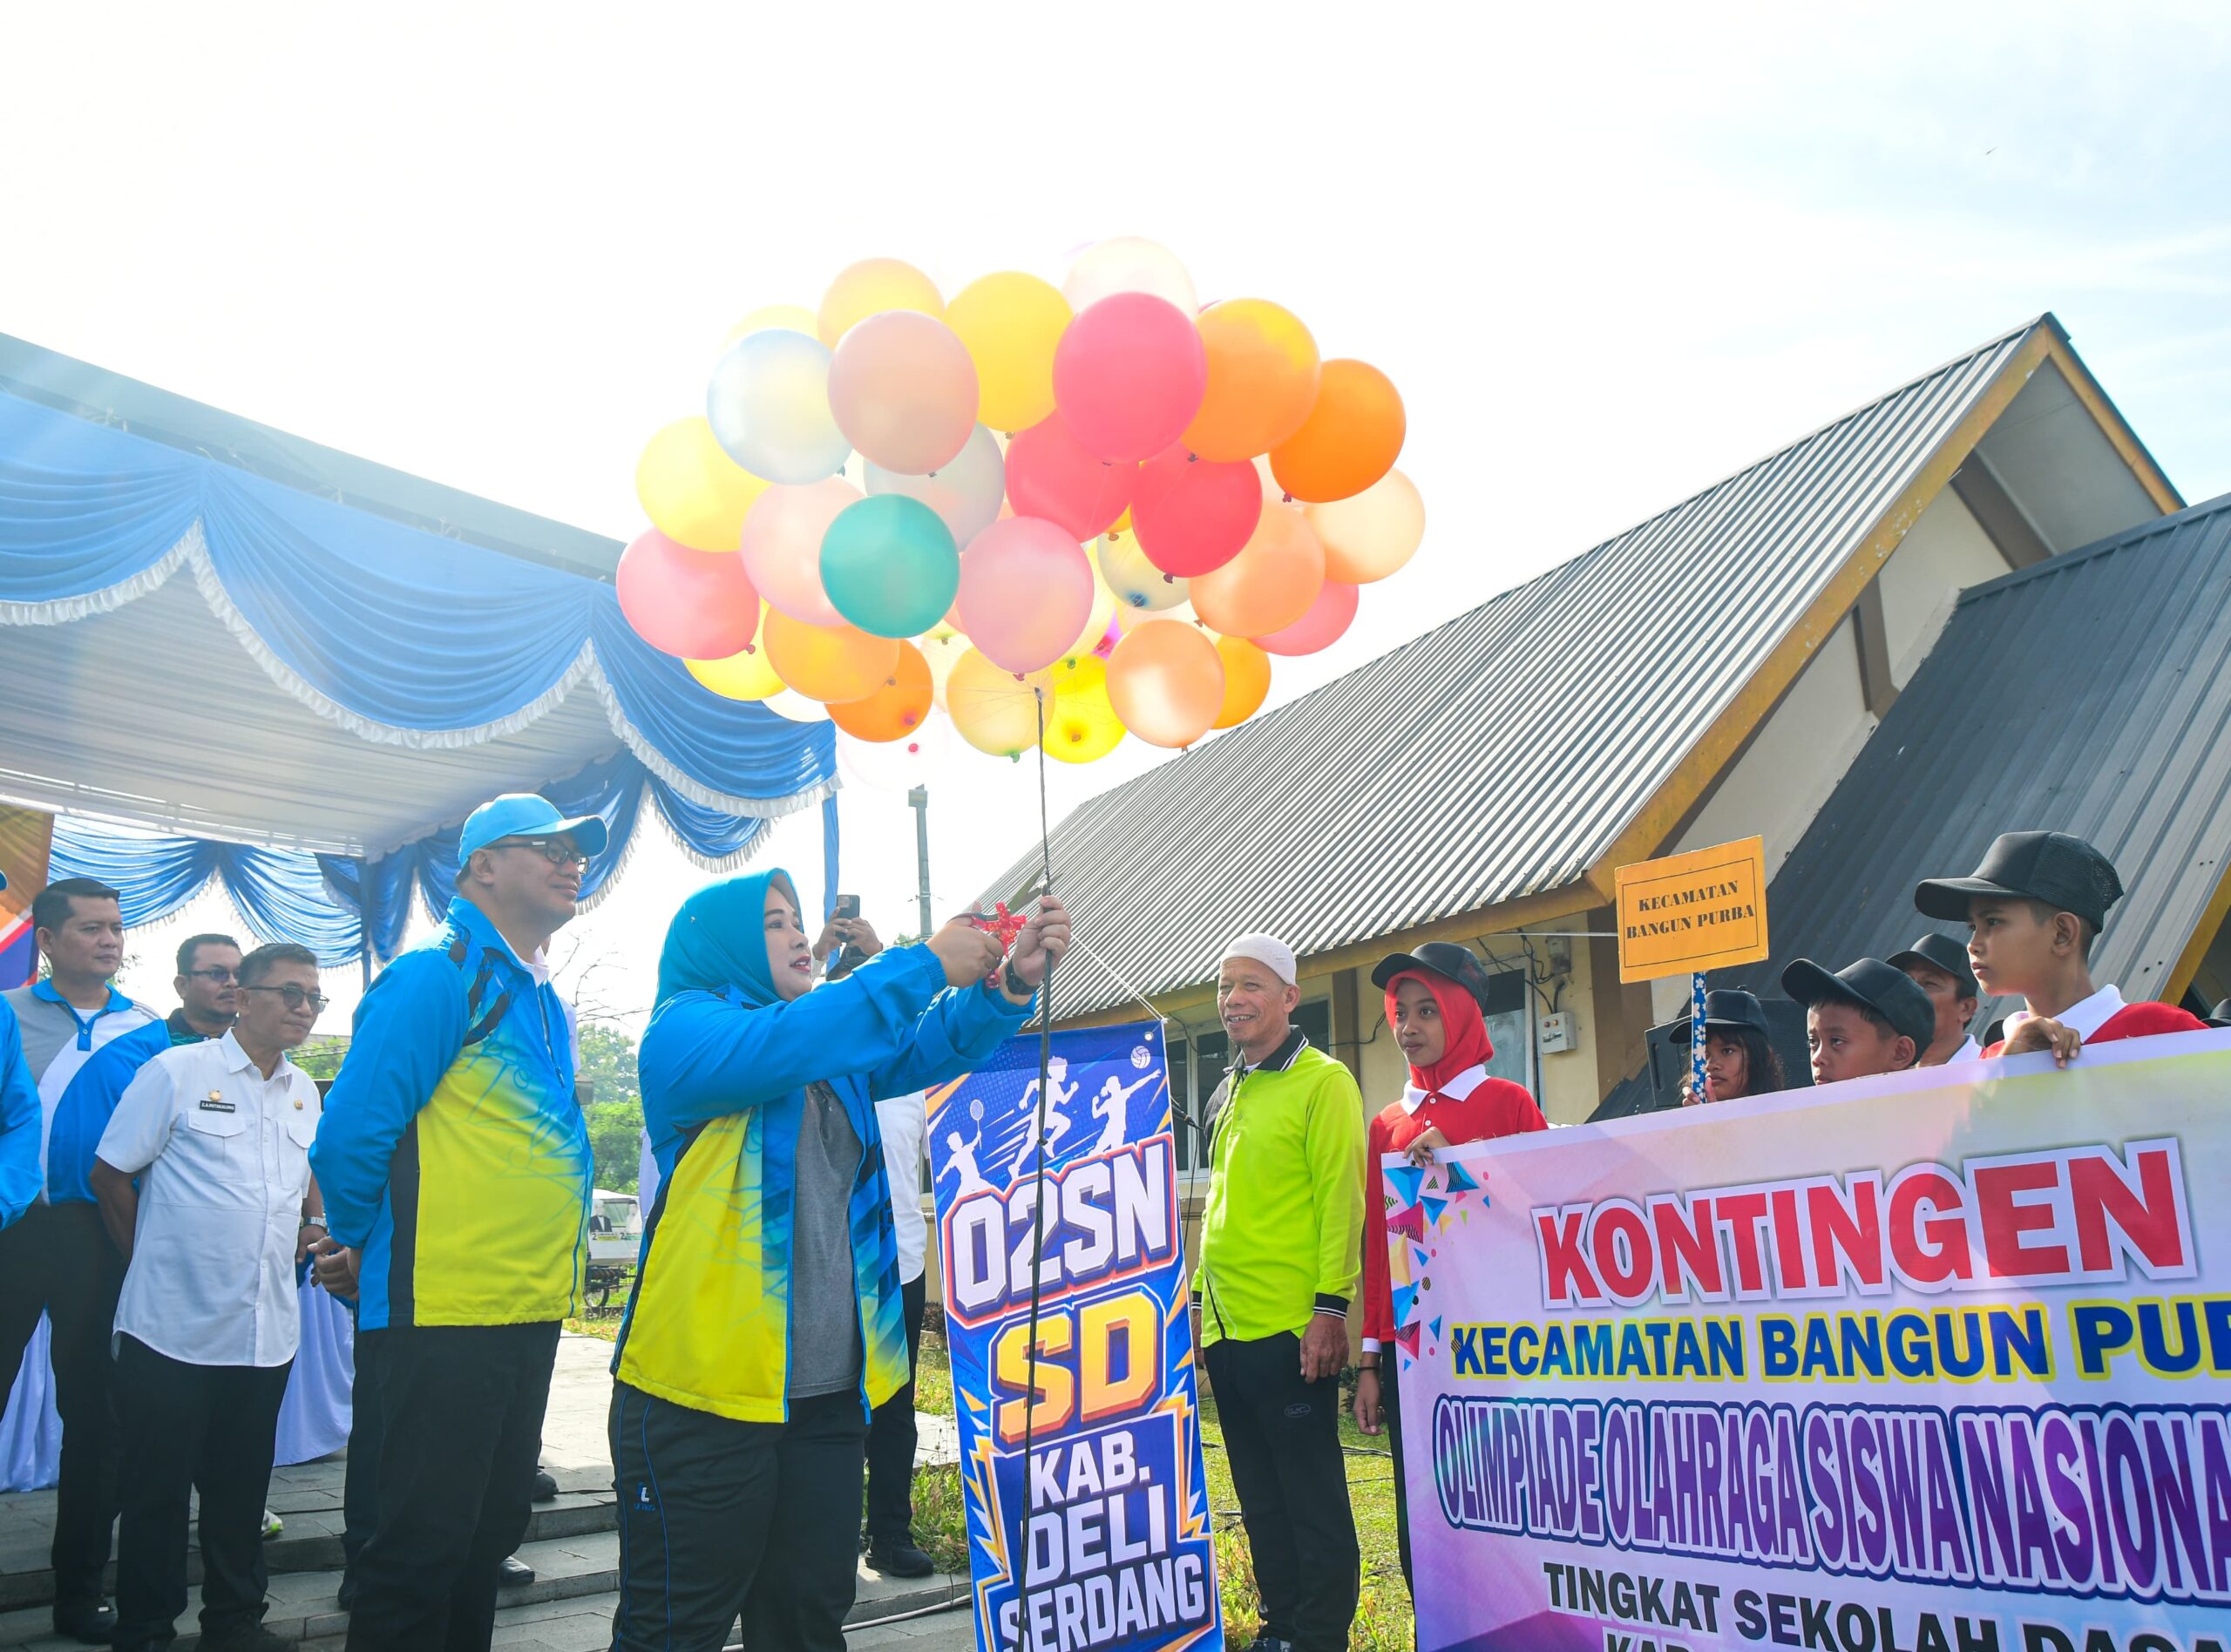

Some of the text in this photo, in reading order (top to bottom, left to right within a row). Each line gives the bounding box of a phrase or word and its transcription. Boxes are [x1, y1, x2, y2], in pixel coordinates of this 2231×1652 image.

[1626, 904, 1755, 939] BANGUN PURBA
[1638, 880, 1739, 911] KECAMATAN
[1537, 1148, 2187, 1301] KONTINGEN
[998, 1291, 1159, 1445] SD
[1454, 1319, 1744, 1377] KECAMATAN
[1761, 1309, 2050, 1378] BANGUN
[1030, 1430, 1150, 1510] KAB.
[1441, 1402, 1602, 1538] OLIMPIADE
[1607, 1408, 1809, 1564] OLAHRAGA
[1800, 1411, 1969, 1574] SISWA
[1021, 1484, 1167, 1589] DELI
[1000, 1554, 1205, 1652] SERDANG
[1543, 1561, 1720, 1634] TINGKAT
